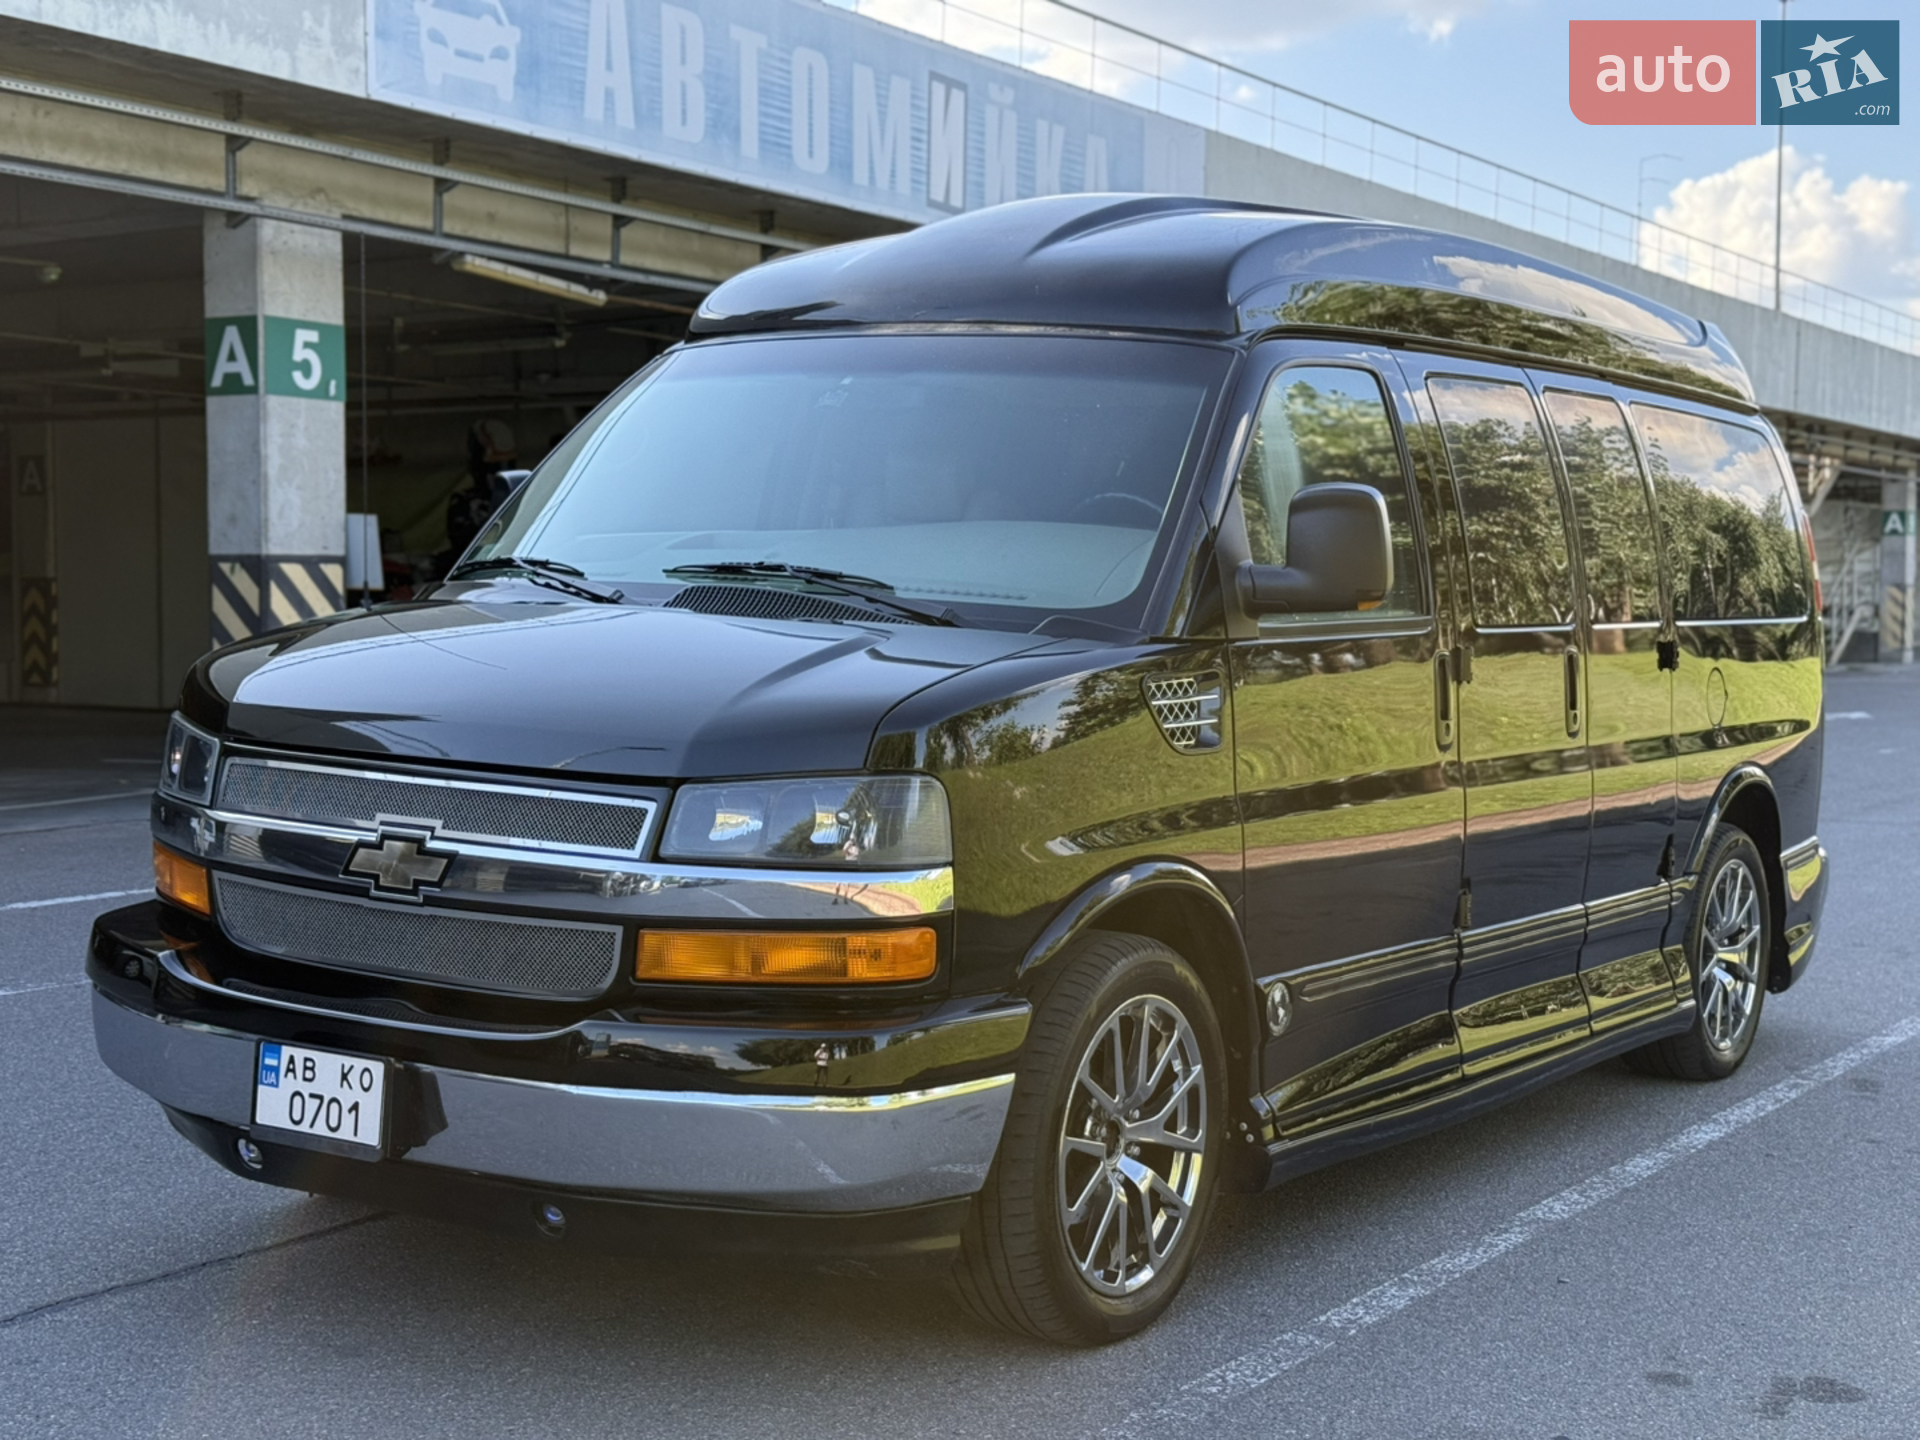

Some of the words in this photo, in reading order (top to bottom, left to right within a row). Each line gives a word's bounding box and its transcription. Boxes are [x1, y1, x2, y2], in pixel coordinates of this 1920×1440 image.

[262, 1069, 277, 1086] UA
[284, 1054, 316, 1083] AB
[340, 1063, 374, 1093] KO
[289, 1090, 360, 1137] 0701
